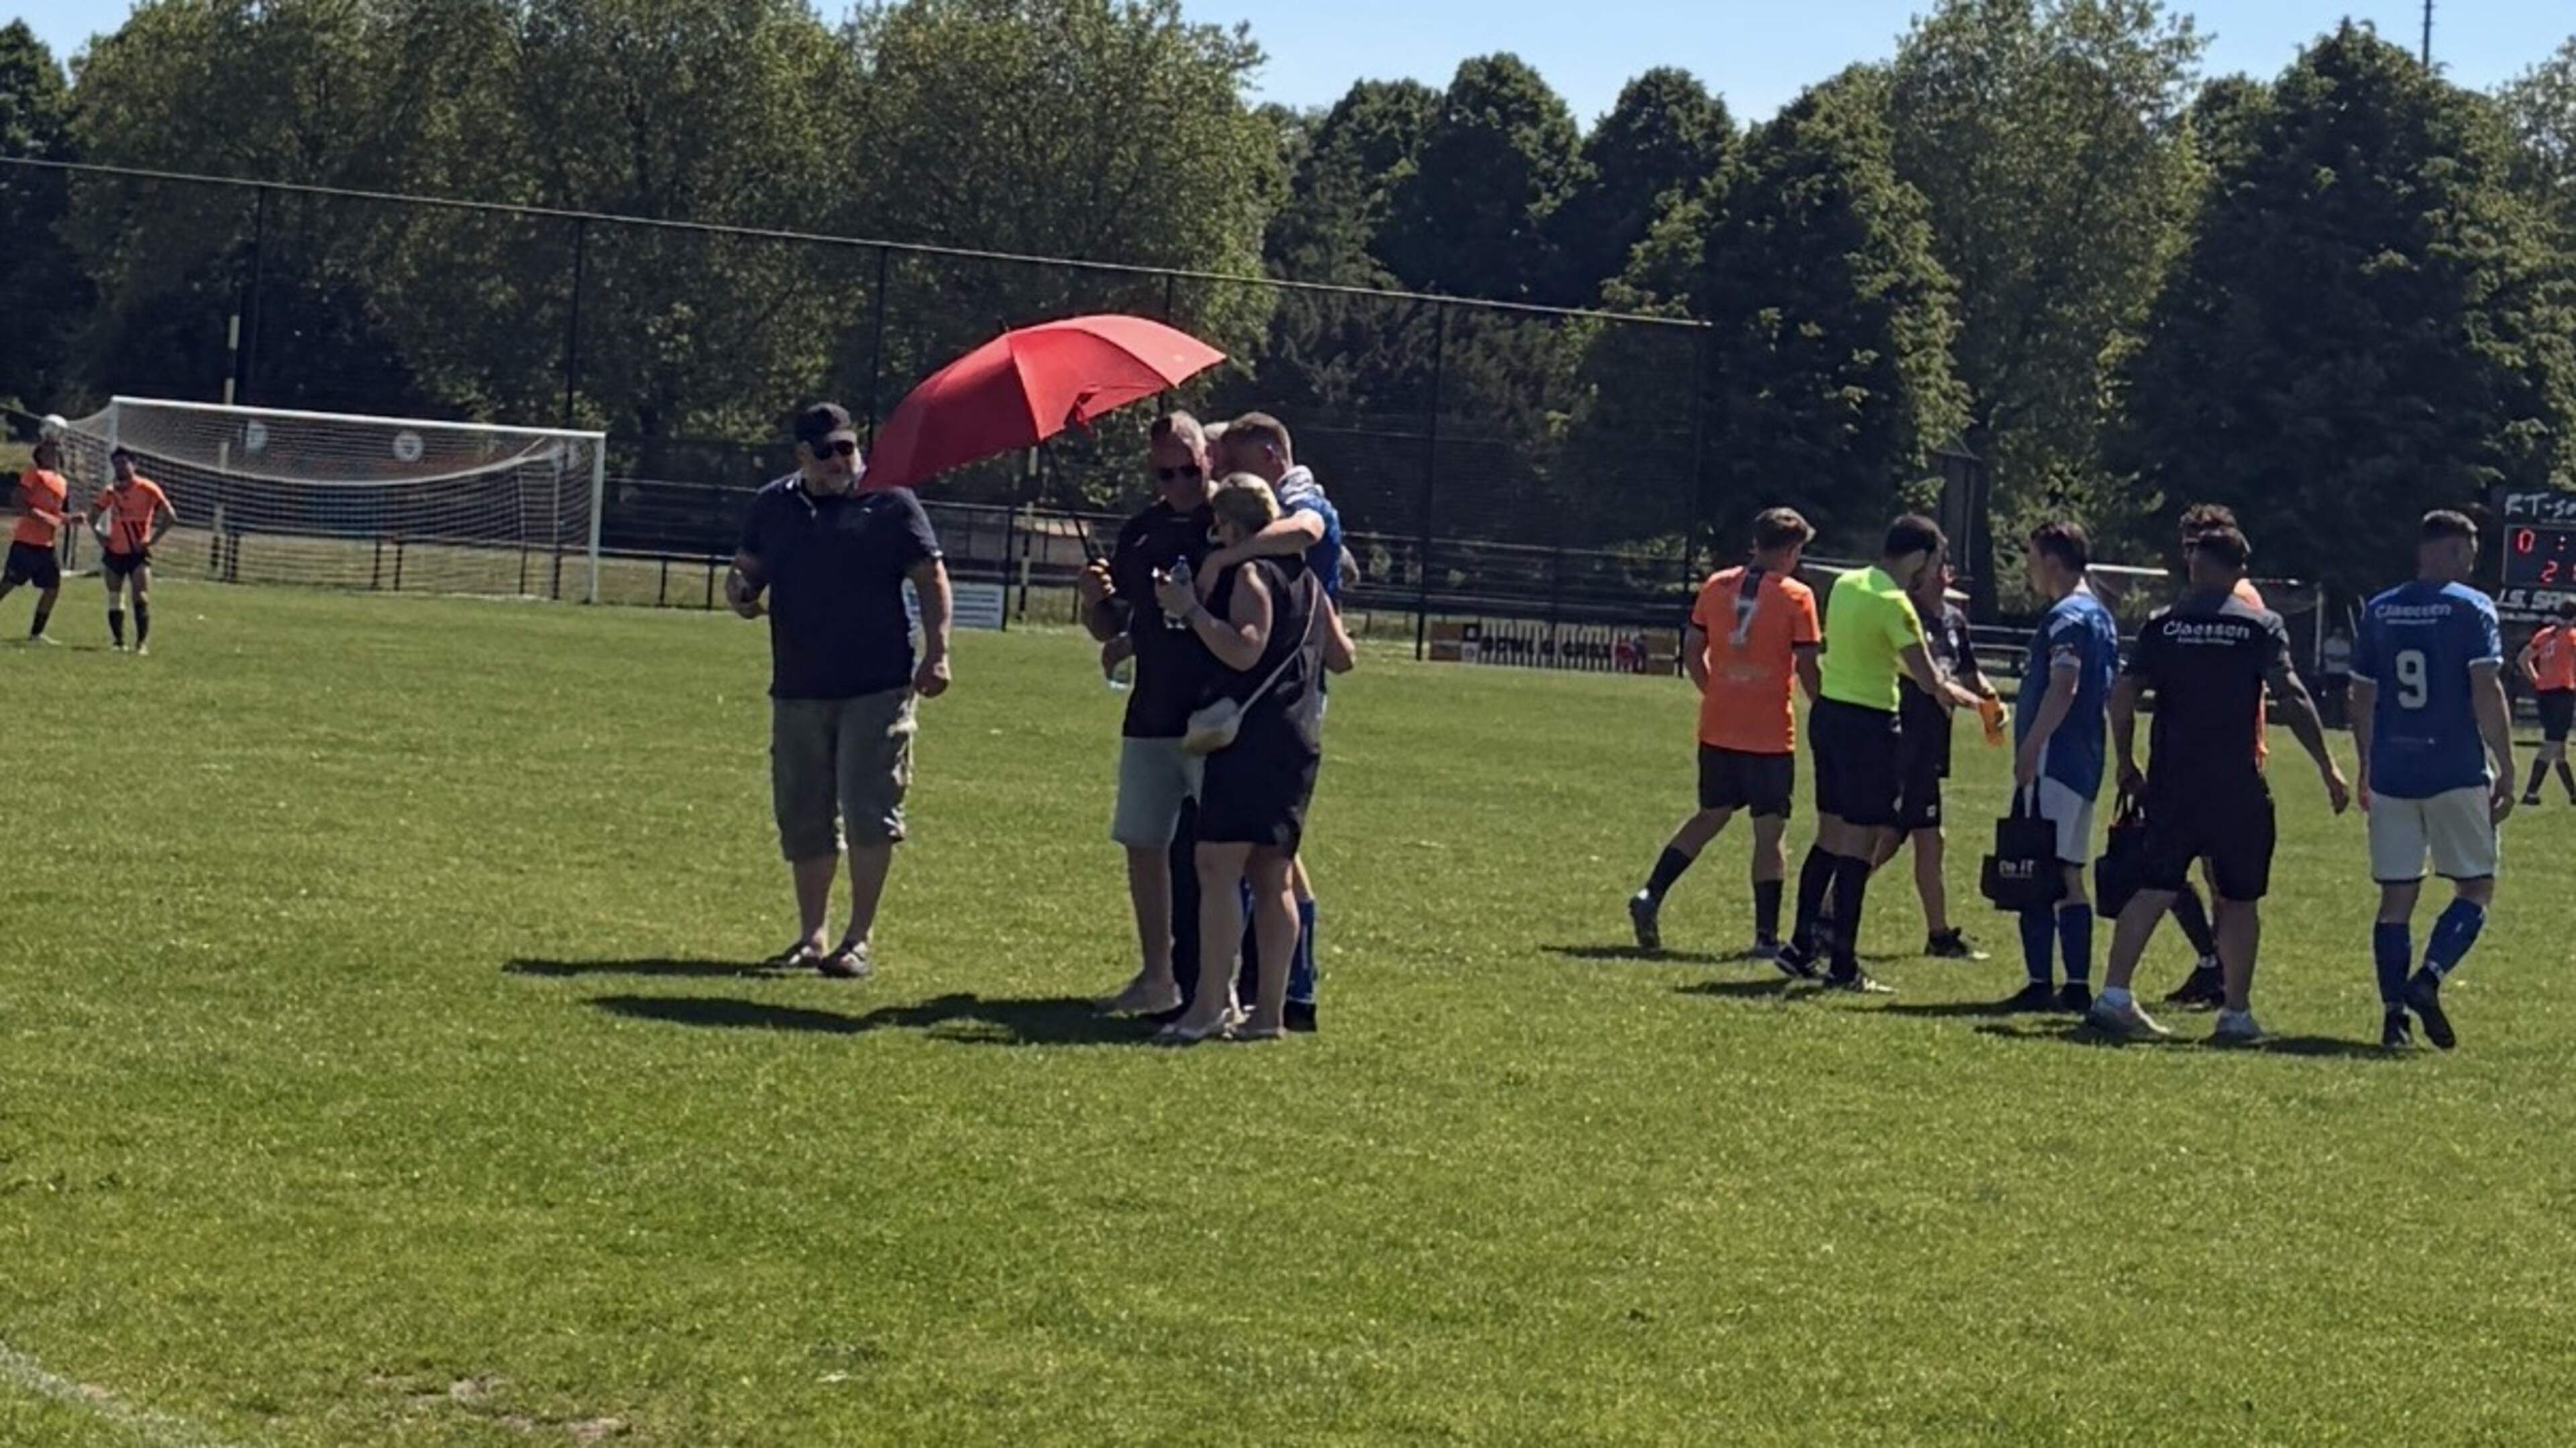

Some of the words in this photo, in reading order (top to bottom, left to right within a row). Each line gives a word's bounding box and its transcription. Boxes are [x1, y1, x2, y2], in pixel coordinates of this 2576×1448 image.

[2517, 528, 2536, 554] 0
[2540, 560, 2559, 582] 2
[1729, 598, 1758, 646] 7
[2396, 649, 2428, 709] 9
